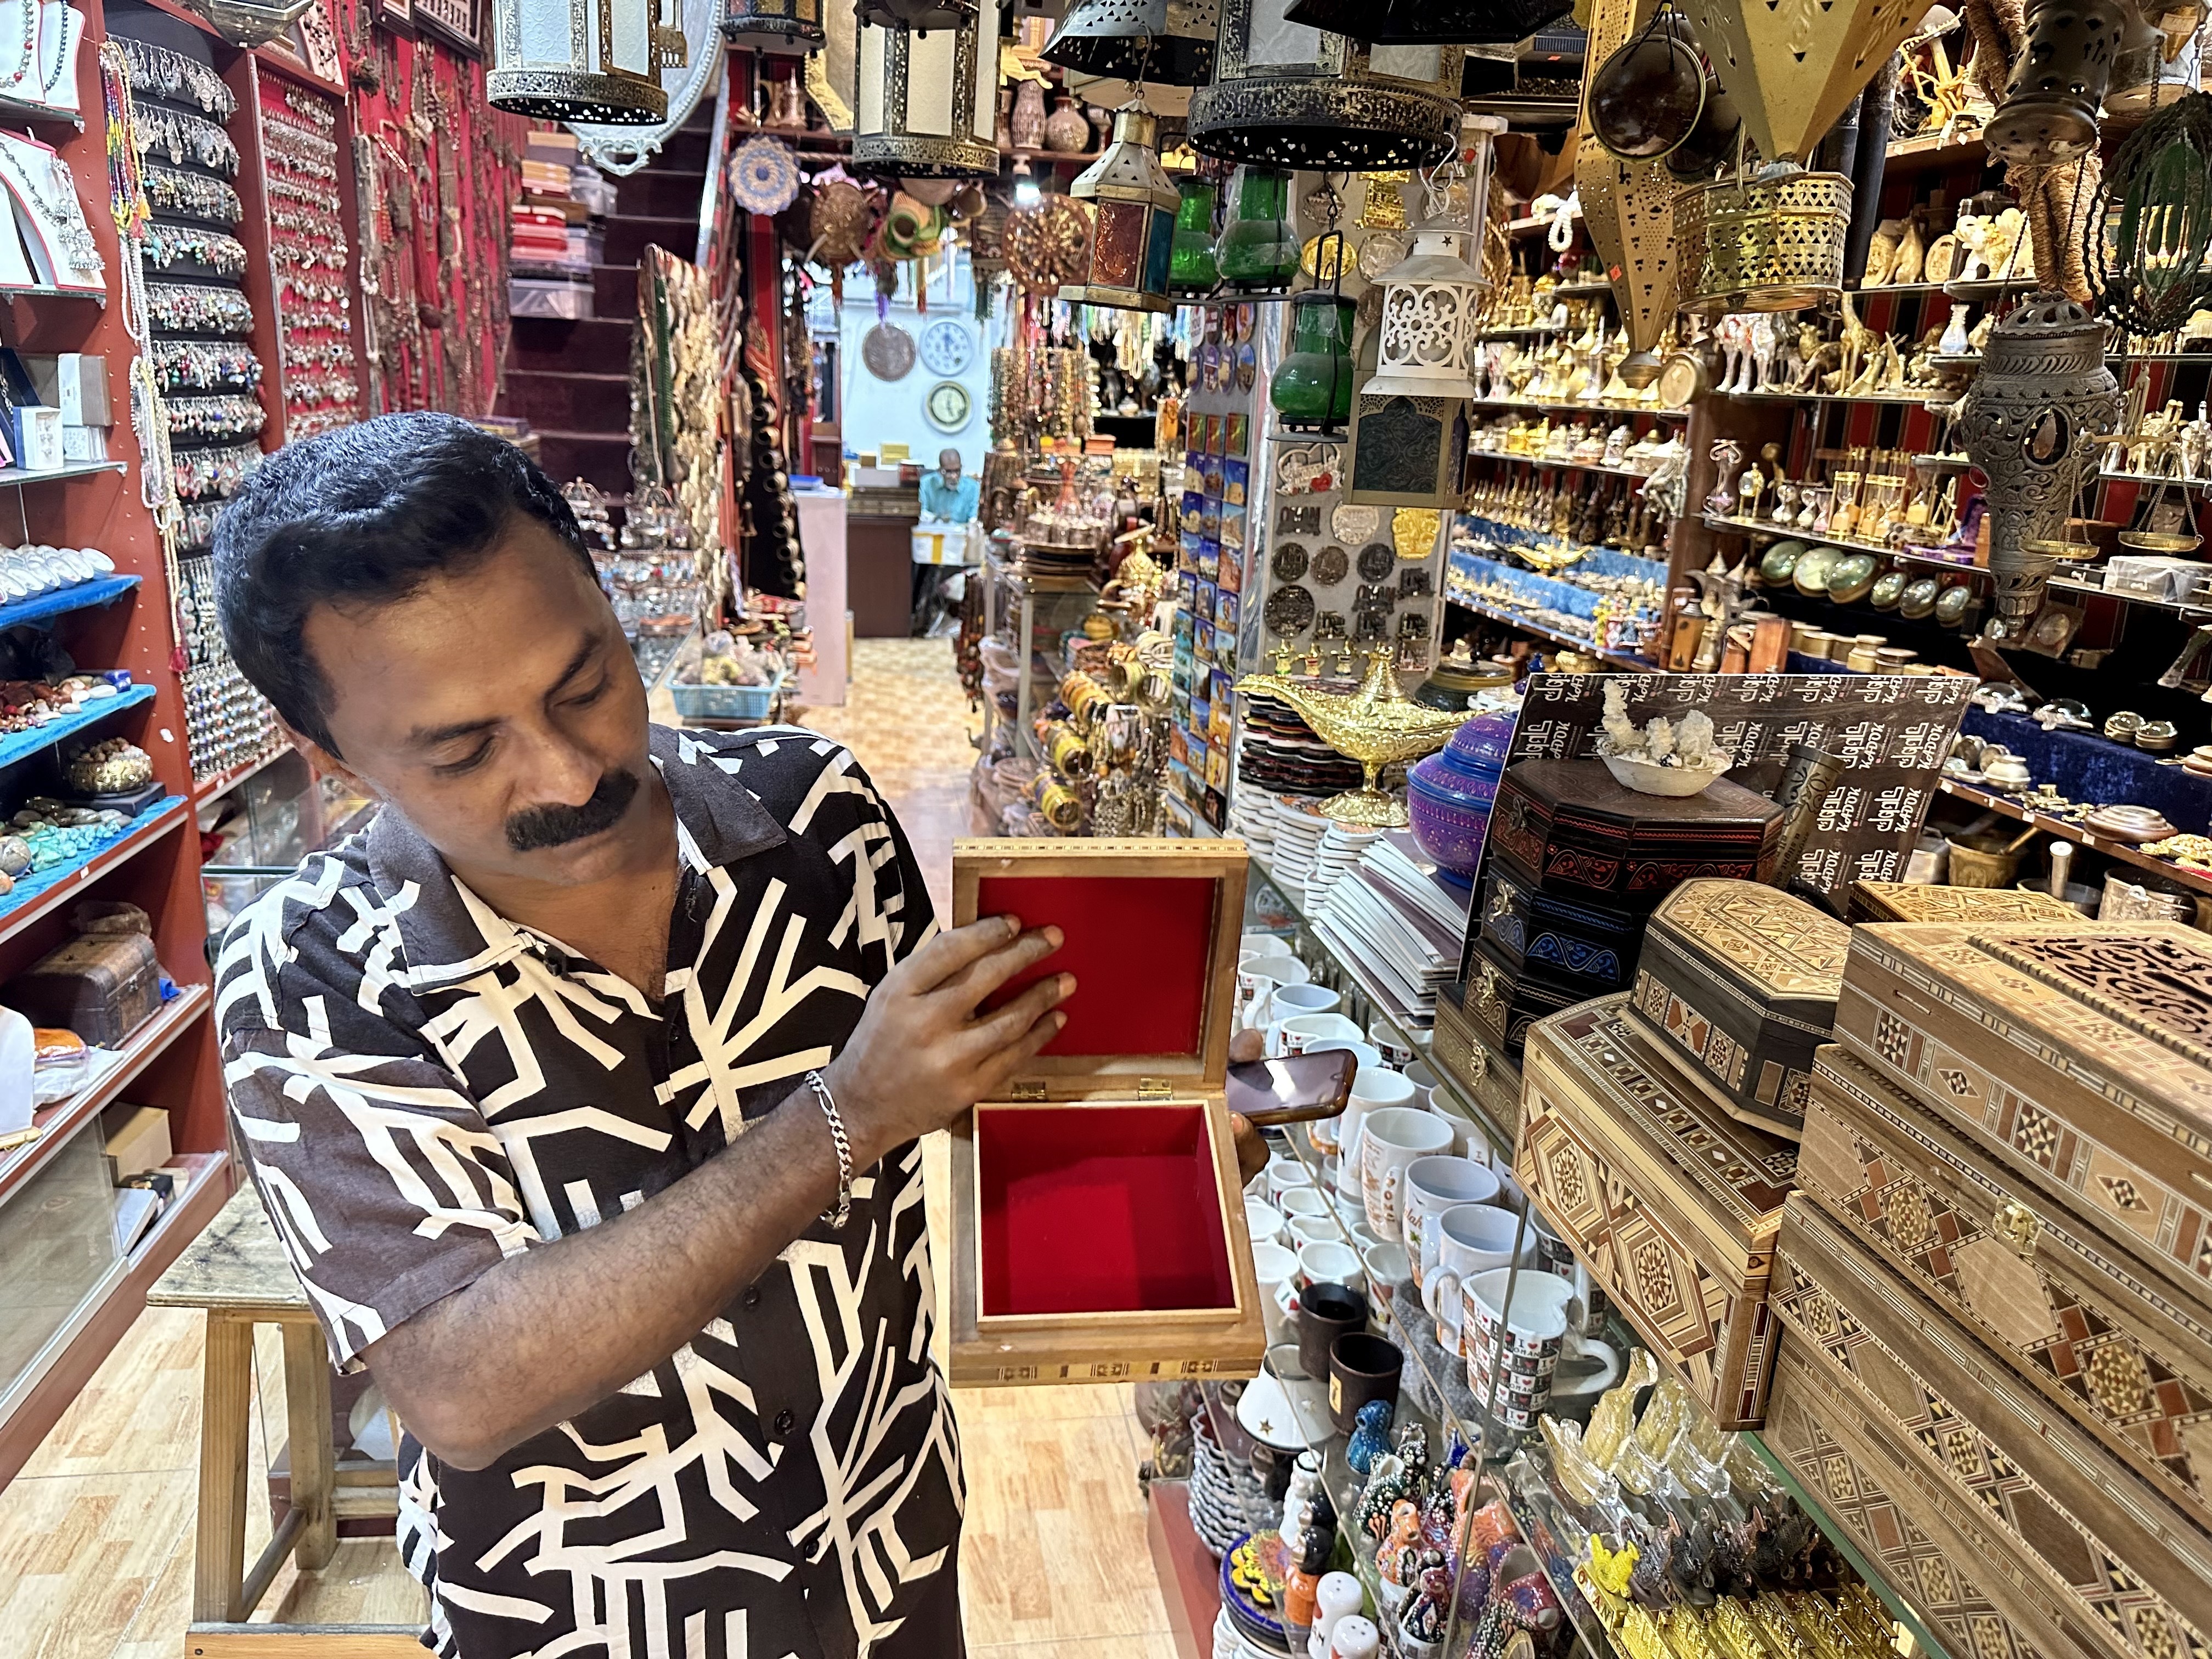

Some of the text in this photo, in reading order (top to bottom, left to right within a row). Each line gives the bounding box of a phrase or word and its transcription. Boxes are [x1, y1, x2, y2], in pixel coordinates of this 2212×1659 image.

[1565, 675, 1585, 702] KAD
[1632, 675, 1651, 703] KAD
[1697, 676, 1716, 703] KAD
[1759, 676, 1780, 703] KAD
[1821, 677, 1842, 703] KAD
[1882, 677, 1903, 704] KAD
[1942, 678, 1963, 705] KAD
[1515, 720, 1554, 759] كادو
[1549, 721, 1571, 759] ADOK
[1736, 721, 1763, 768] KADOK
[1804, 722, 1824, 748] DOK
[1859, 722, 1885, 770] KADOK
[1891, 722, 1929, 769] كادوك
[1917, 723, 1945, 770] KADOK
[1836, 787, 1861, 833] KADOK
[1867, 786, 1905, 832] كادوك
[1894, 787, 1921, 833] KADOK
[1798, 849, 1825, 886] كادو
[1880, 850, 1899, 883] ADOK
[1554, 1263, 1559, 1274] I
[1513, 1347, 1539, 1357] OMAN
[1518, 1338, 1525, 1348] I
[1511, 1365, 1537, 1375] OMAN
[1516, 1357, 1521, 1366] I
[1509, 1383, 1533, 1393] OMAN
[1513, 1375, 1519, 1384] I
[1513, 1393, 1516, 1402] I
[1510, 1410, 1514, 1419] I
[1578, 1570, 1611, 1622] OMAN
